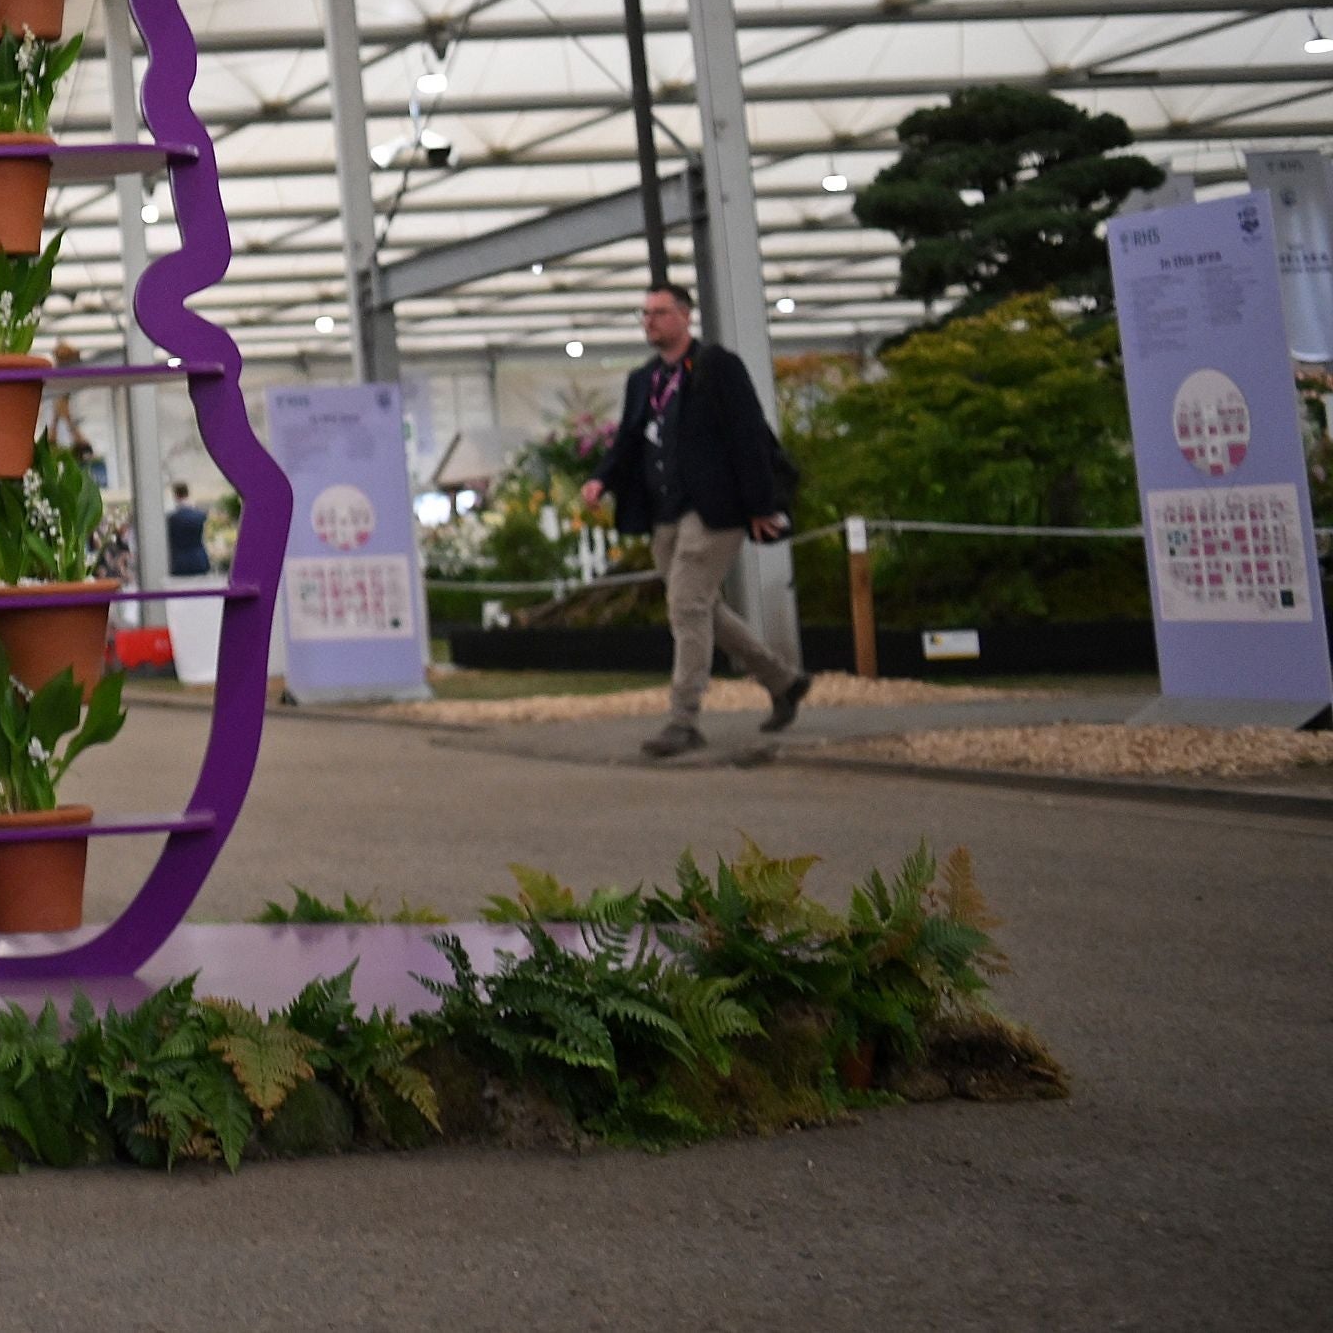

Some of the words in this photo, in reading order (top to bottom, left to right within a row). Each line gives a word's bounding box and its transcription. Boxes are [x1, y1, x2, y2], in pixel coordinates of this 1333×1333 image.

[1133, 227, 1161, 246] RHS
[1160, 258, 1171, 270] In
[1173, 253, 1194, 267] this
[1197, 250, 1222, 265] area
